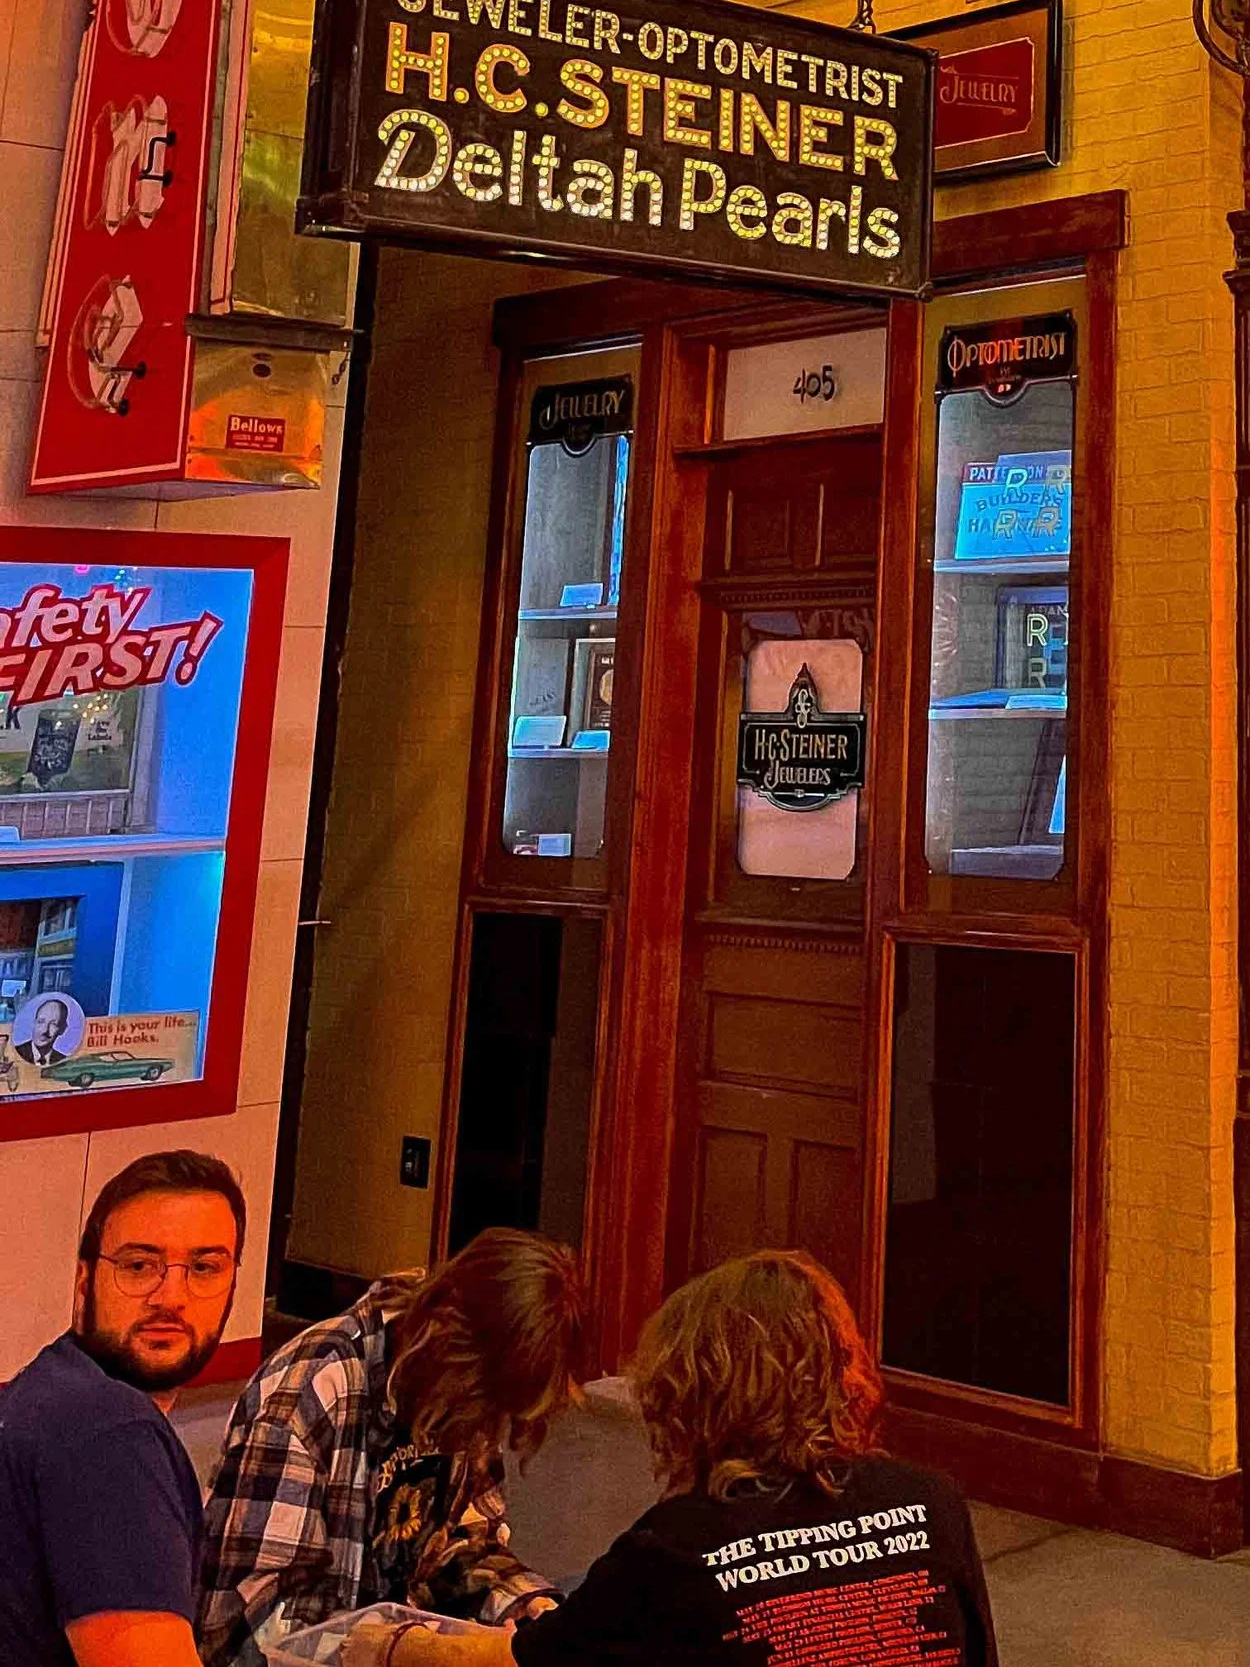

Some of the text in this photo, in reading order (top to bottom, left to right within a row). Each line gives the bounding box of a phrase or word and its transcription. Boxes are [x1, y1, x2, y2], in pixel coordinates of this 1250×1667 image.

[374, 108, 900, 259] Deltah Pearls
[947, 333, 1066, 377] OPTOMETRIST
[793, 365, 835, 404] 405
[230, 416, 283, 434] Bellows
[539, 389, 626, 430] JEWELRY
[764, 759, 831, 788] JEWELERS
[87, 1035, 107, 1047] Bill
[88, 1022, 113, 1034] This
[117, 1020, 126, 1032] is
[131, 1022, 159, 1035] your
[702, 1504, 927, 1566] THE TIPPING POINT
[715, 1531, 931, 1592] WORLD TOUR 2022
